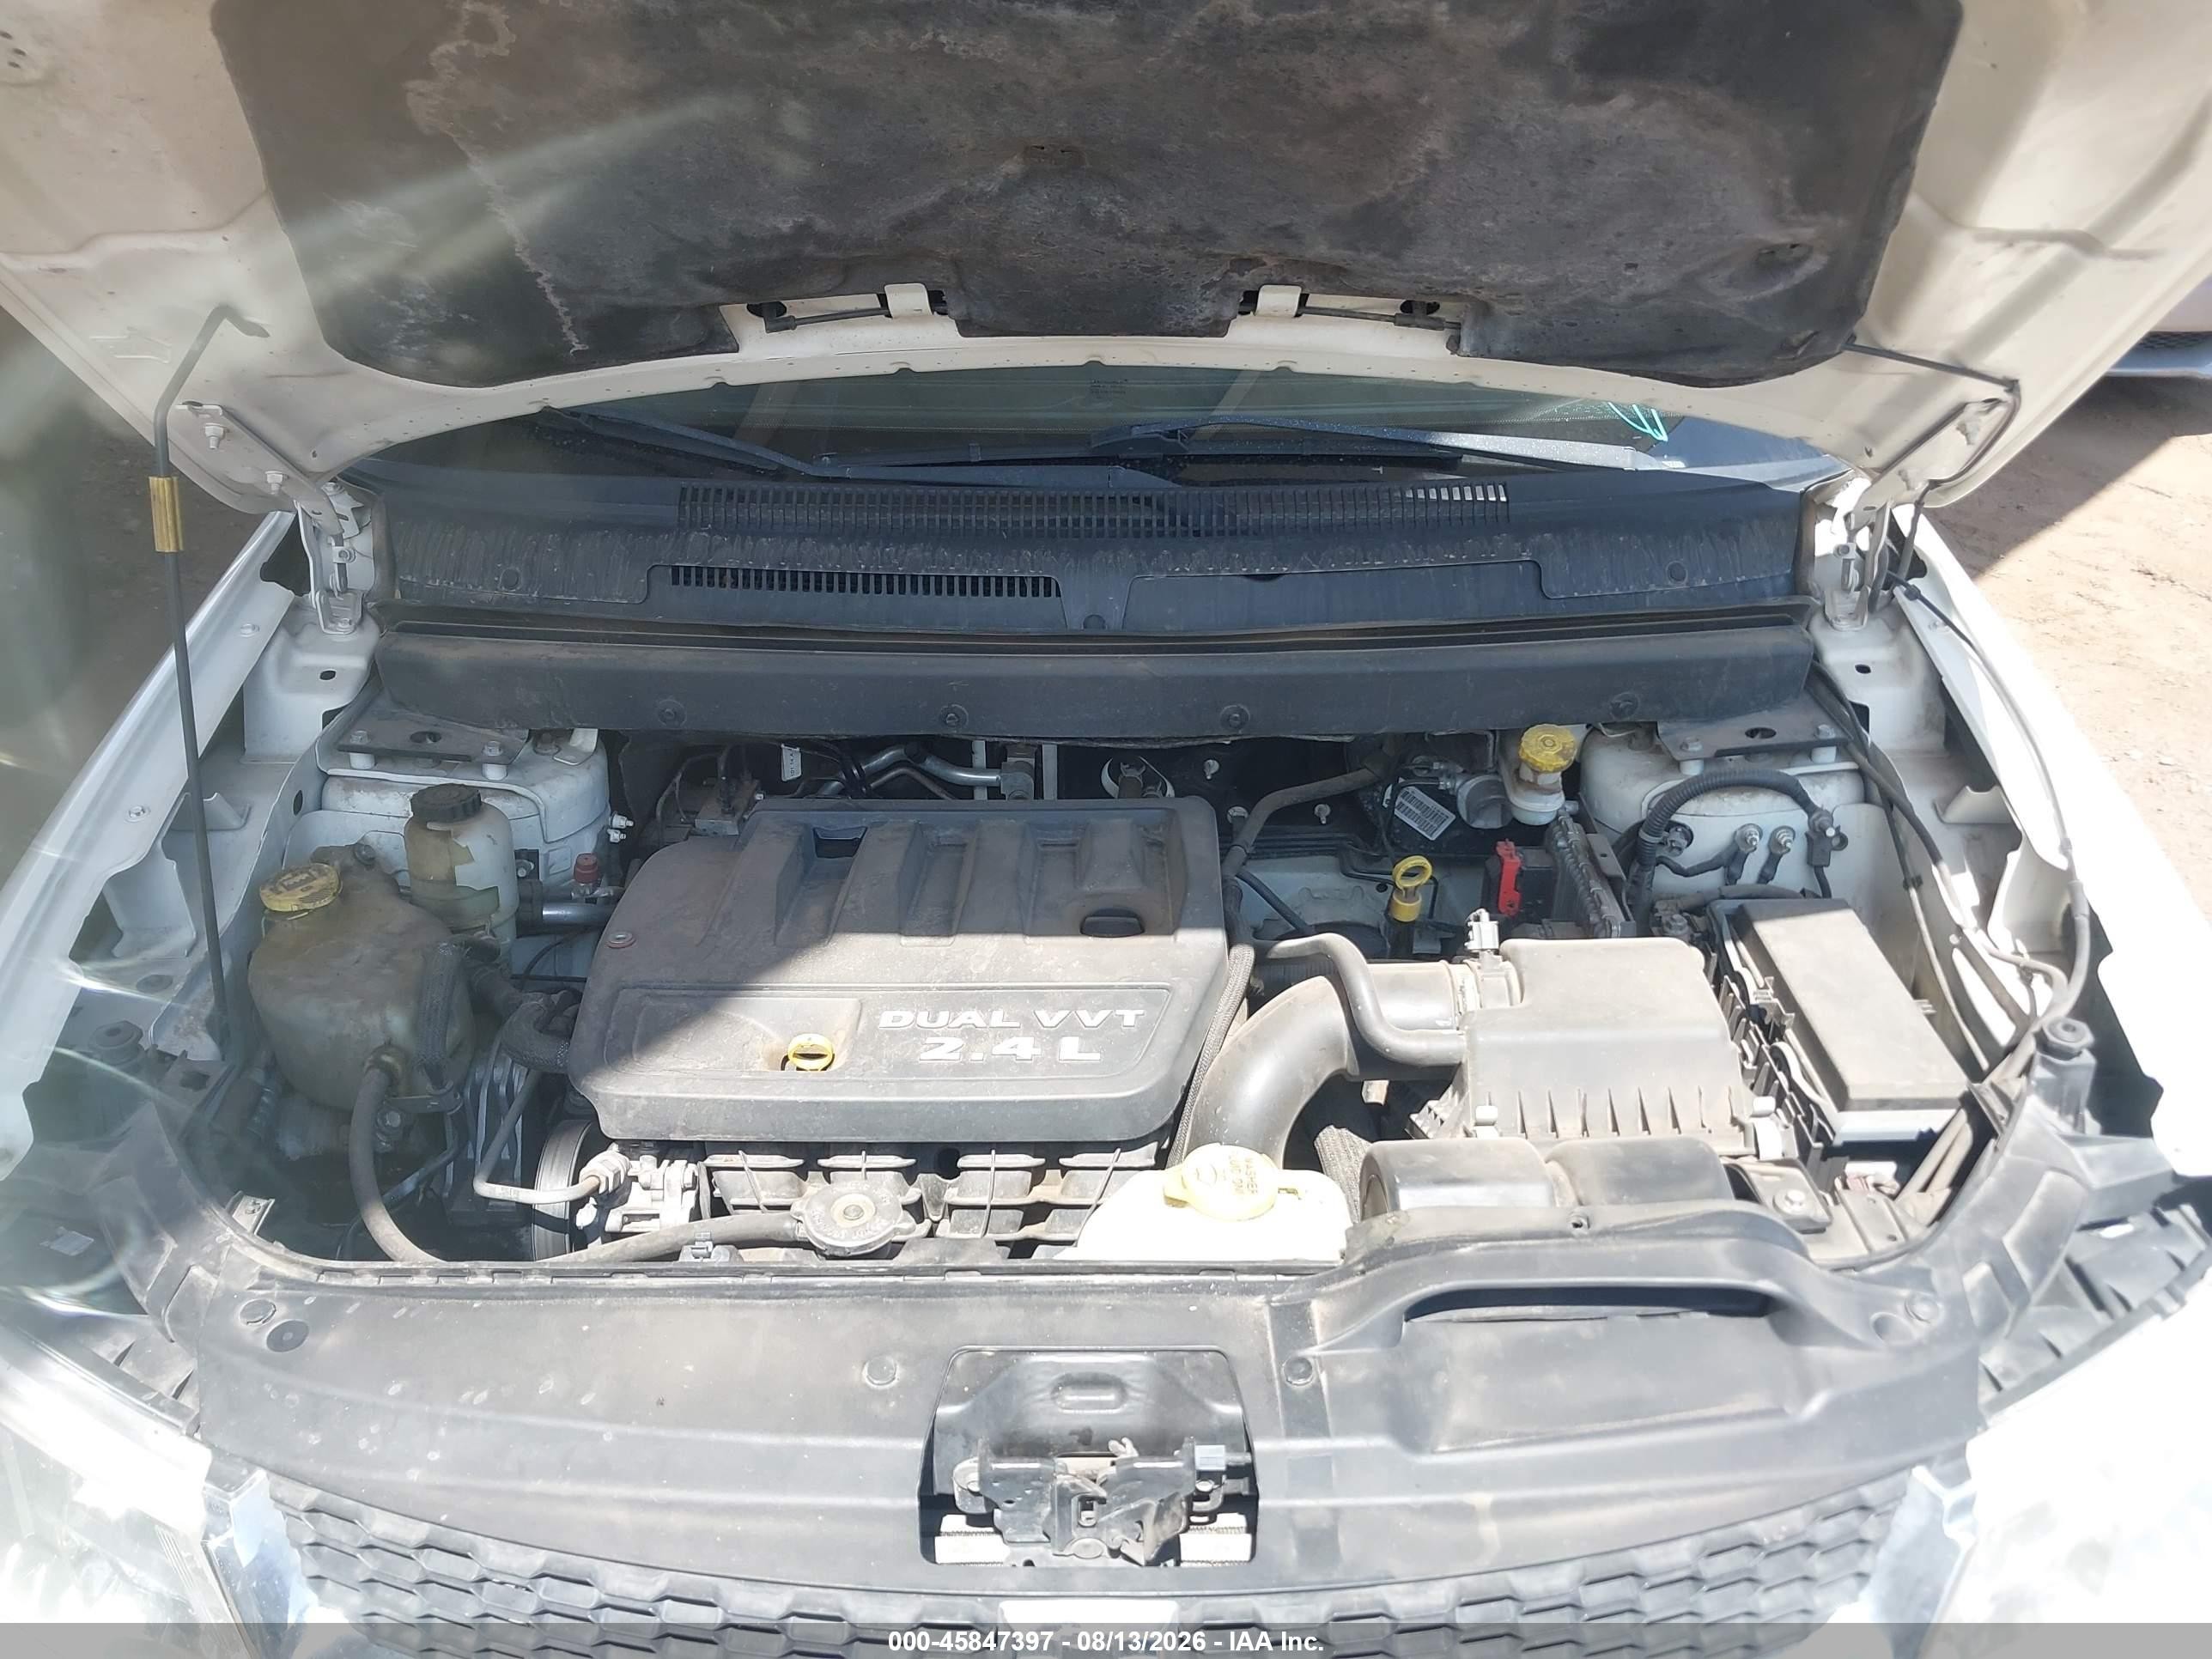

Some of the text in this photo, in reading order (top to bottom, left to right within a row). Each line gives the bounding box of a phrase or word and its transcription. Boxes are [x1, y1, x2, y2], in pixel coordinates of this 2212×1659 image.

[879, 1010, 1145, 1029] DUAL VVT
[919, 1036, 1101, 1061] 2.4 L
